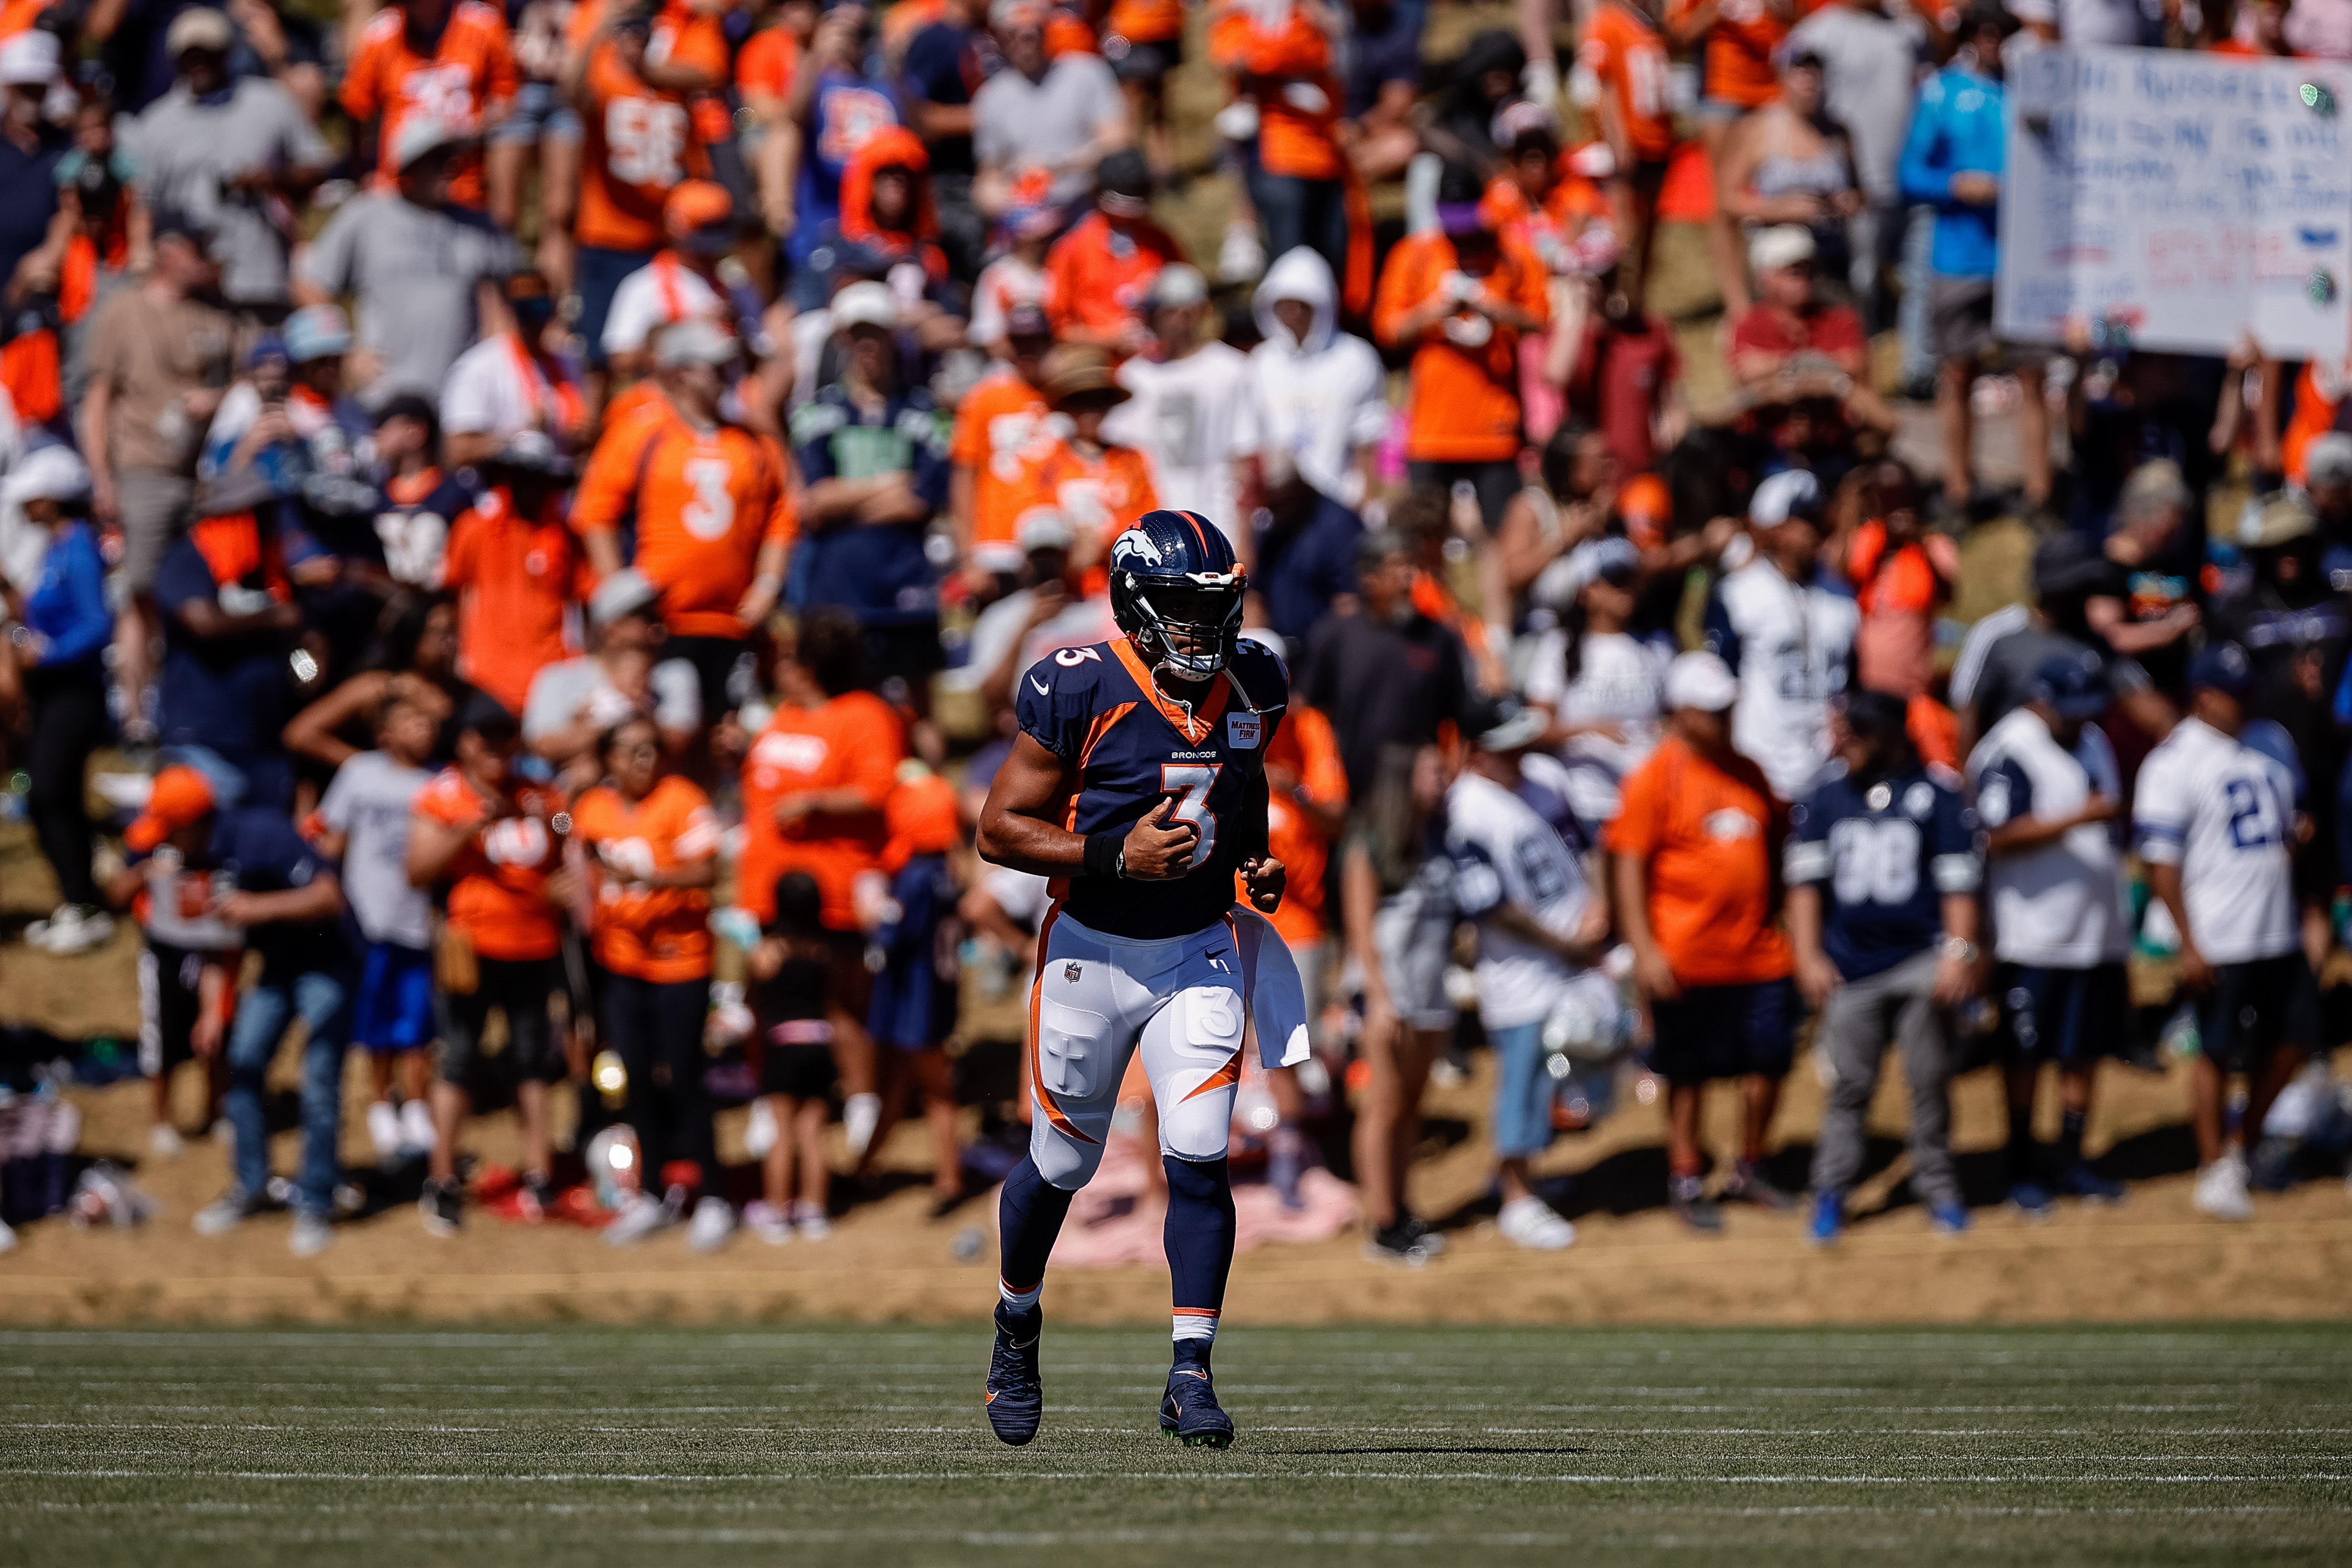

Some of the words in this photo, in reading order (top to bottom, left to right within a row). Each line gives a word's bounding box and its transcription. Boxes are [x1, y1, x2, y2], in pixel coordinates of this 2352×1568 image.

[680, 459, 736, 540] 3
[1055, 647, 1102, 667] 3
[1231, 721, 1260, 730] MATTRESS
[1160, 763, 1223, 871] 3
[1201, 986, 1237, 1037] 3
